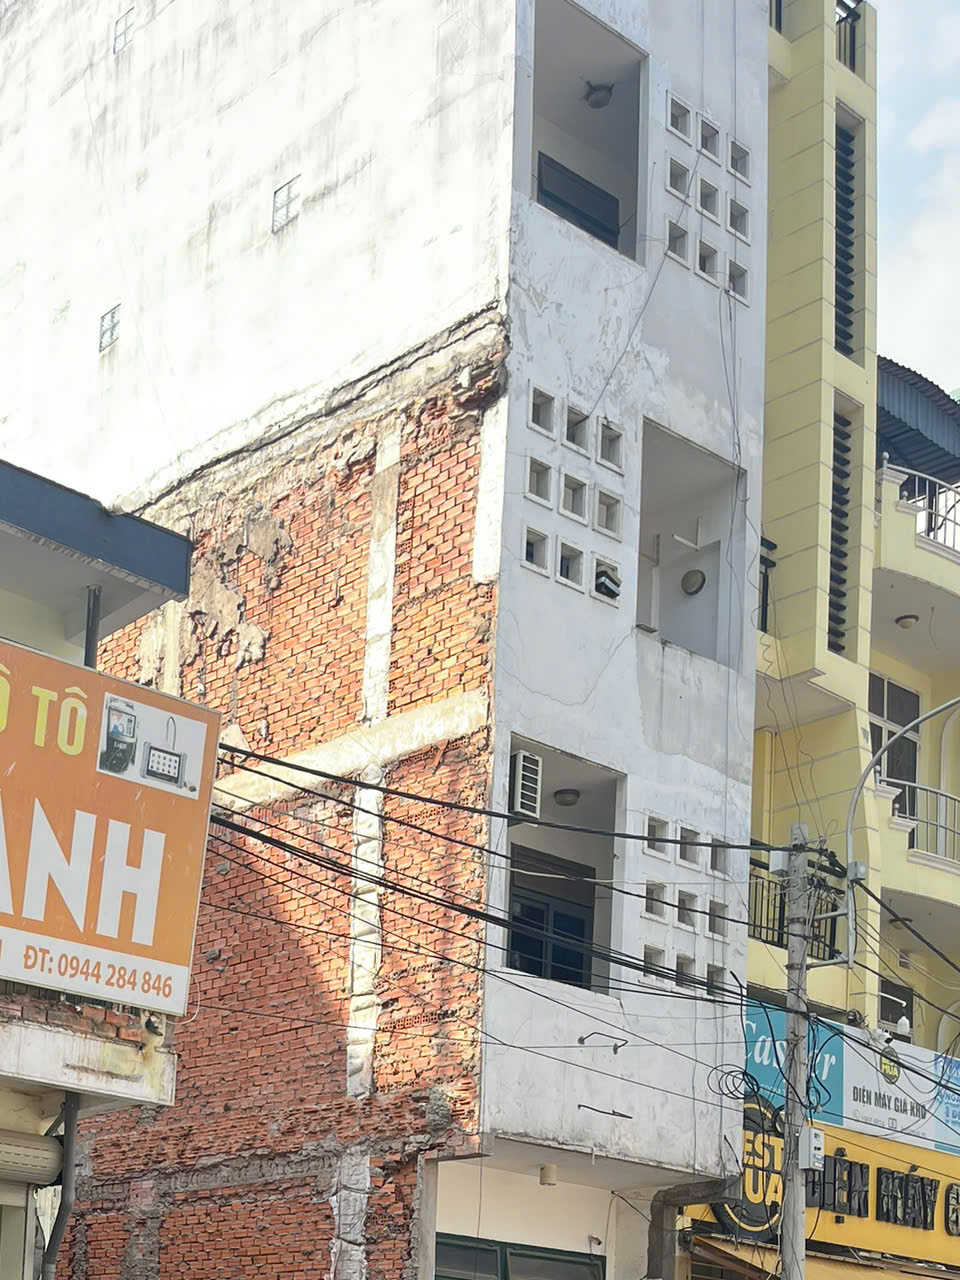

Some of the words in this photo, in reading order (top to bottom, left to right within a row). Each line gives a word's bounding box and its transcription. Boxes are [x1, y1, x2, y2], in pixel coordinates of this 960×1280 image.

[32, 686, 88, 756] TÔ
[23, 944, 54, 975] ĐT:
[58, 953, 102, 985] 0944
[105, 963, 138, 991] 284
[141, 971, 173, 998] 846
[744, 1130, 785, 1171] EST
[744, 1167, 784, 1207] UA
[876, 1164, 940, 1230] MÁY
